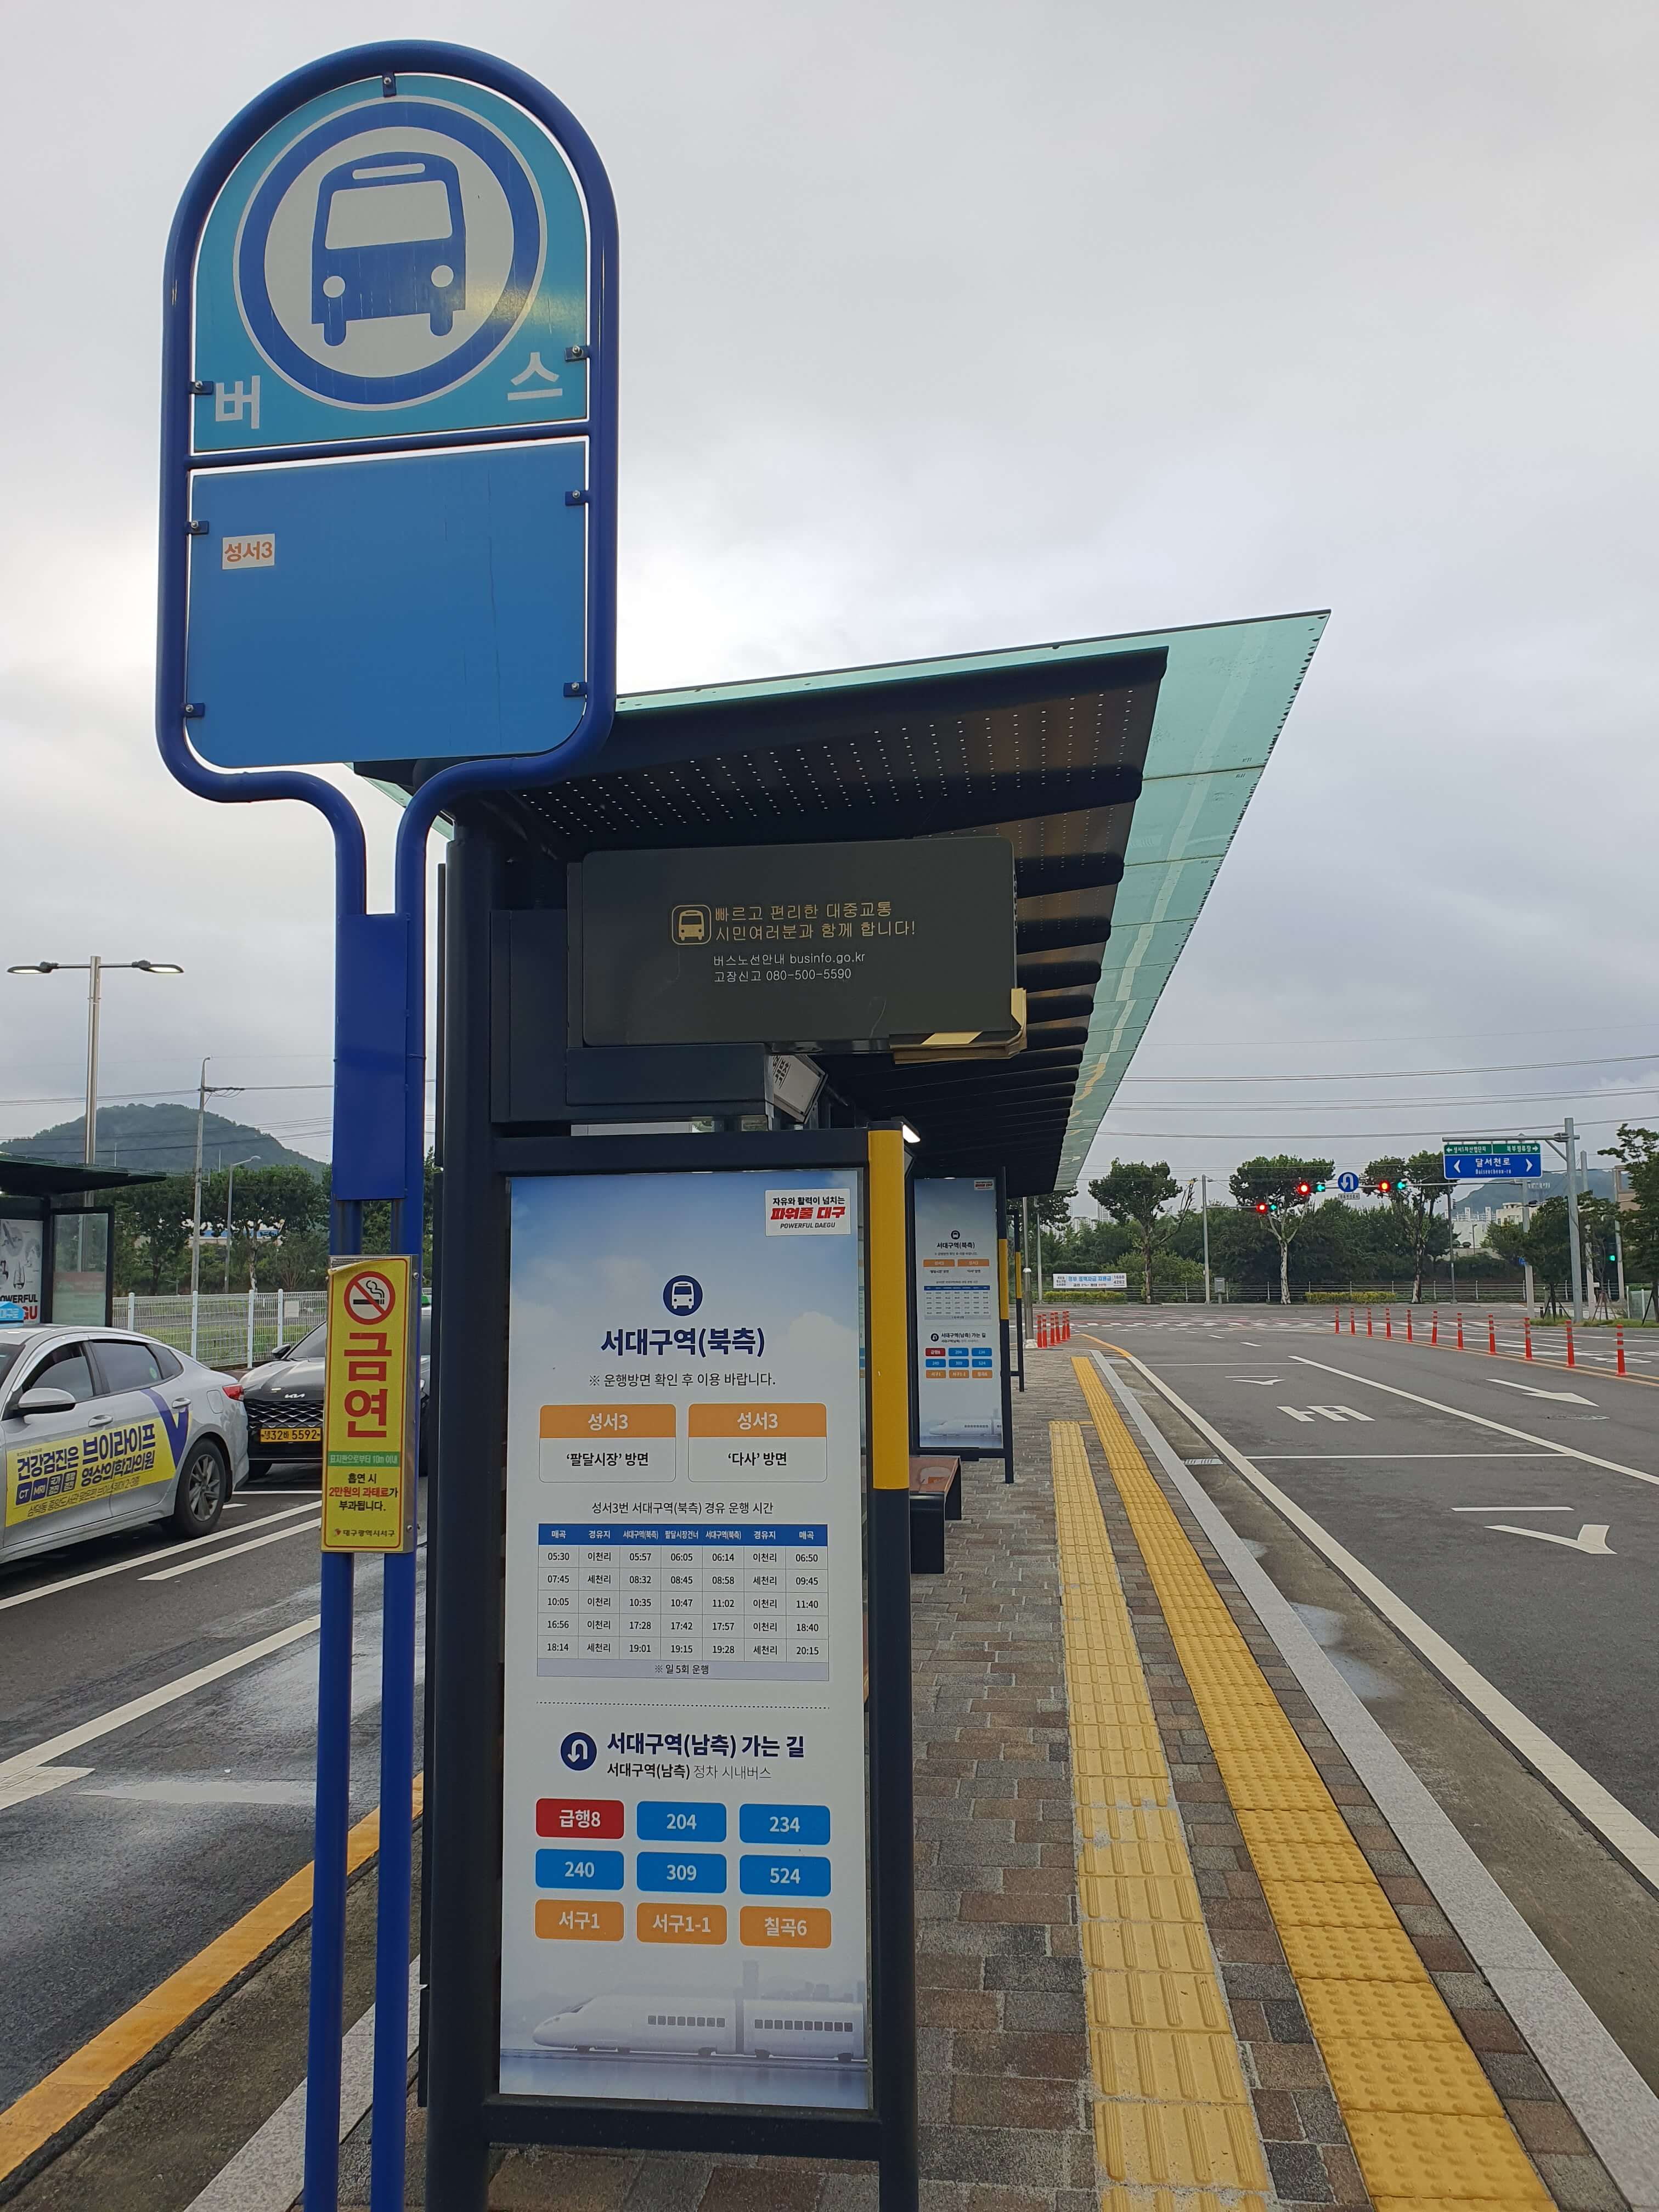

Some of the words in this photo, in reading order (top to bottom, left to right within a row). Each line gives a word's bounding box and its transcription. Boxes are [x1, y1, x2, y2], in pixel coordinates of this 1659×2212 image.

[224, 540, 273, 562] 성서3
[716, 907, 763, 922] 빠르고
[771, 905, 818, 919] 편리한
[827, 902, 891, 918] 대중교통
[716, 923, 814, 941] 시민여러분과
[822, 923, 851, 938] 함께
[861, 921, 914, 936] 합니다!
[714, 954, 784, 966] 버스노선안내
[791, 952, 865, 963] businfo.go.kr
[715, 971, 761, 982] 고장신고
[766, 968, 851, 980] 080-500-5590
[1476, 1158, 1510, 1167] 달서천로
[773, 1197, 795, 1206] 자유와
[798, 1197, 820, 1205] 활력이
[823, 1196, 845, 1205] 넘치는
[771, 1207, 814, 1220] 파워풀
[816, 1206, 846, 1218] 대구
[601, 1328, 764, 1357] 서대구역(북측)
[344, 1333, 392, 1437] 금연
[604, 1374, 650, 1387] 운행방면
[655, 1374, 677, 1386] 확인
[682, 1374, 693, 1386] 후
[698, 1373, 720, 1386] 이용
[725, 1373, 775, 1386] 바랍니다.
[588, 1413, 628, 1430] 성서3
[737, 1412, 777, 1430] 성서3
[292, 1430, 317, 1440] 5592
[82, 1423, 155, 1465] 브이라이프
[18, 1446, 78, 1481] 건강검진은
[330, 1455, 370, 1463] 표지판으로부터
[386, 1455, 397, 1463] 이내
[625, 1453, 648, 1466] 방면
[764, 1452, 786, 1465] 방면
[81, 1451, 155, 1487] 영상의학과의원
[348, 1473, 365, 1483] 흡연
[368, 1474, 376, 1483] 시
[19, 1489, 30, 1499] CT
[34, 1485, 45, 1495] MRI
[329, 1487, 360, 1497] 2만원의
[363, 1487, 398, 1497] 과태료가
[339, 1500, 386, 1511] 부과됩니다.
[592, 1502, 628, 1514] 성서3번
[633, 1502, 701, 1515] 서대구역(북측)
[705, 1503, 725, 1514] 경유
[729, 1503, 748, 1514] 운행
[753, 1503, 773, 1514] 시간
[623, 1531, 658, 1539] 서대구역(북측)
[665, 1531, 698, 1539] 팔달시장건너
[706, 1531, 741, 1539] 서대구역(북측)
[754, 1531, 775, 1539] 경유지
[799, 1531, 814, 1539] 매곡
[588, 1552, 611, 1561] 이천리
[712, 1554, 734, 1562] 06:14
[753, 1553, 776, 1562] 이천리
[588, 1575, 611, 1583] 세천리
[753, 1576, 776, 1585] 세천리
[588, 1598, 610, 1606] 이천리
[753, 1599, 777, 1608] 이천리
[588, 1621, 610, 1629] 이천리
[754, 1622, 777, 1631] 이천리
[587, 1643, 610, 1652] 세천리
[753, 1646, 777, 1655] 세천리
[666, 1664, 673, 1674] 일
[676, 1664, 689, 1674] 5회
[692, 1665, 708, 1675] 운행
[607, 1733, 736, 1758] 서대구역(남측)
[742, 1735, 780, 1757] 가는
[787, 1736, 804, 1757] 길
[607, 1763, 690, 1780] 서대구역(남측)
[694, 1765, 718, 1778] 정차
[723, 1766, 771, 1780] 시내버스
[560, 1810, 601, 1828] 급행8
[667, 1814, 696, 1829] 204
[770, 1816, 800, 1832] 234
[565, 1861, 594, 1877] 240
[667, 1865, 696, 1881] 309
[770, 1868, 800, 1883] 524
[559, 1911, 600, 1929] 서구1
[653, 1914, 710, 1933] 서구1-1
[765, 1917, 806, 1937] 칠곡6
